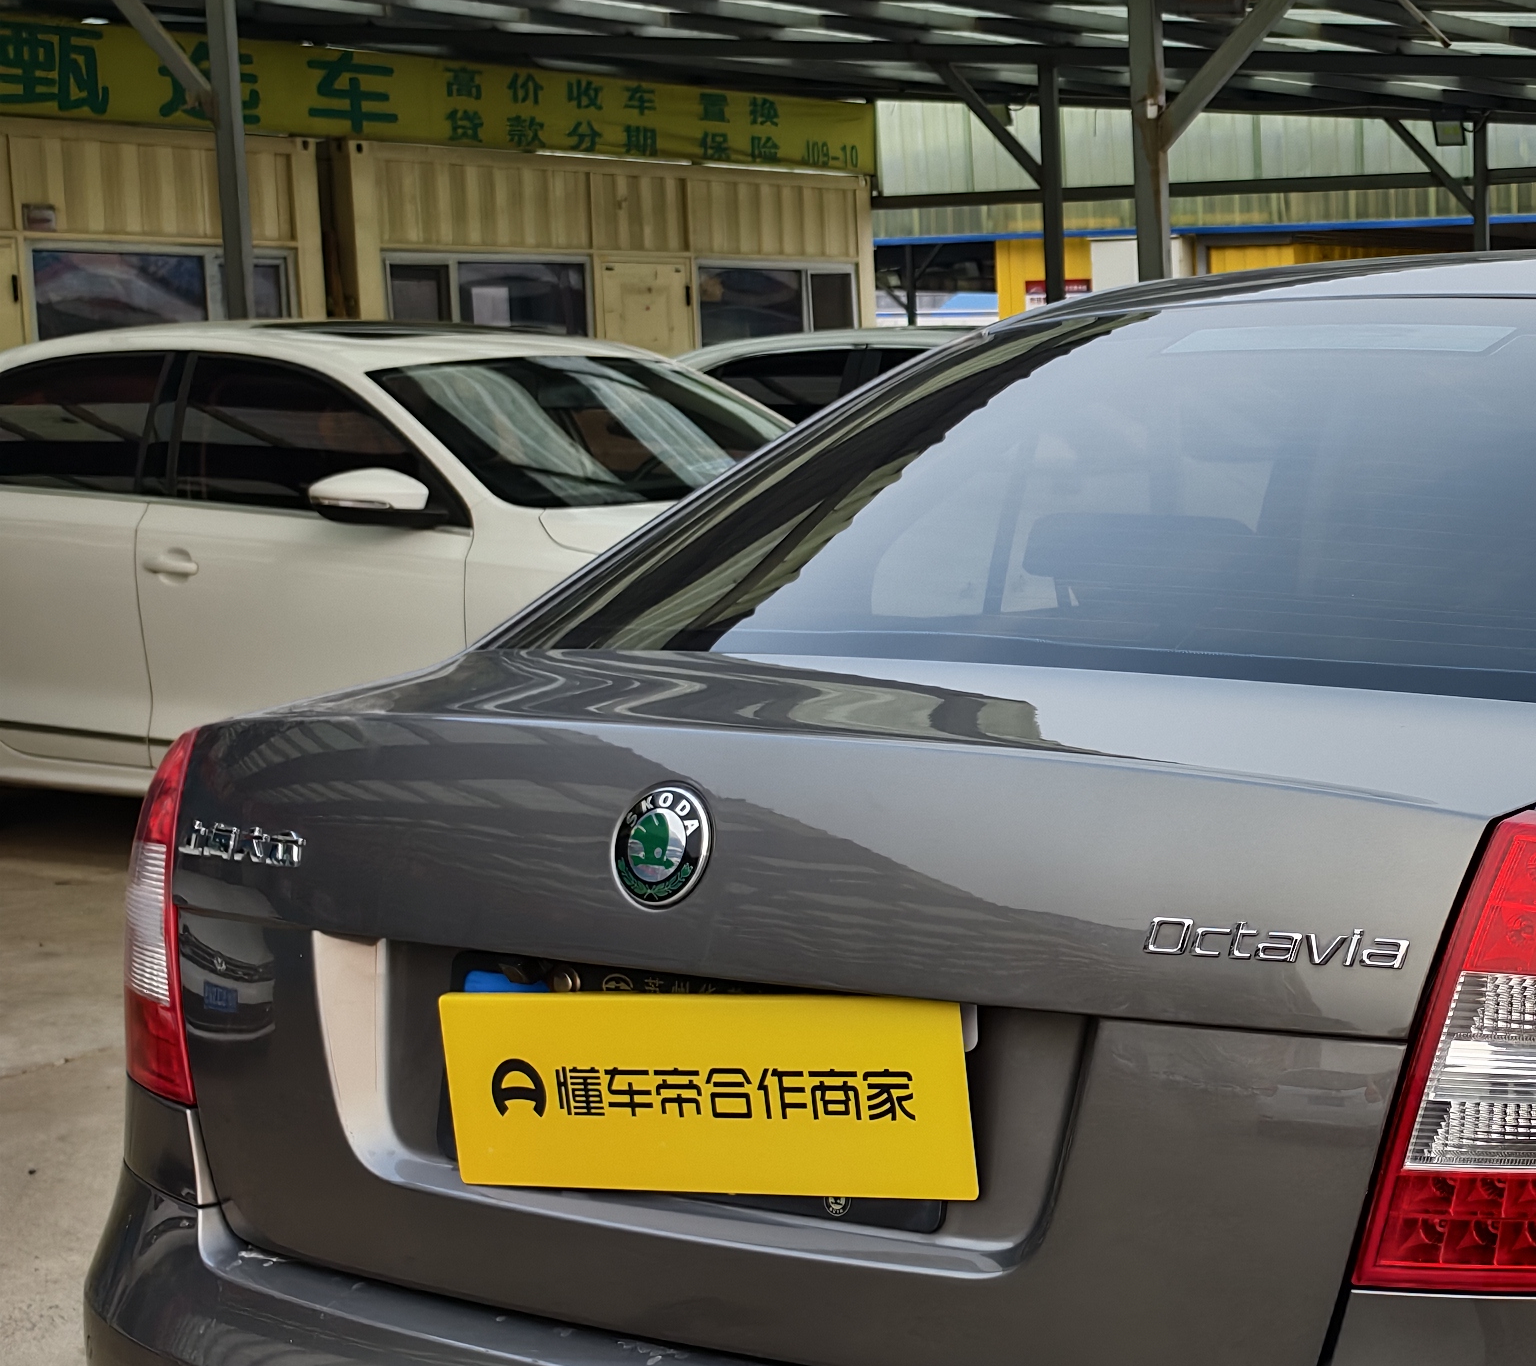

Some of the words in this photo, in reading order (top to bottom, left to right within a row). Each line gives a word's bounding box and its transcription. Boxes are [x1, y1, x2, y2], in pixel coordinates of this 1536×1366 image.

[444, 66, 657, 116] 高价收车
[699, 92, 780, 128] 置换
[445, 108, 658, 157] 贷款分期
[700, 131, 781, 164] 保险
[626, 792, 700, 837] SKODA
[1143, 916, 1411, 969] Octavia
[555, 1065, 917, 1123] 懂车帝合作商家
